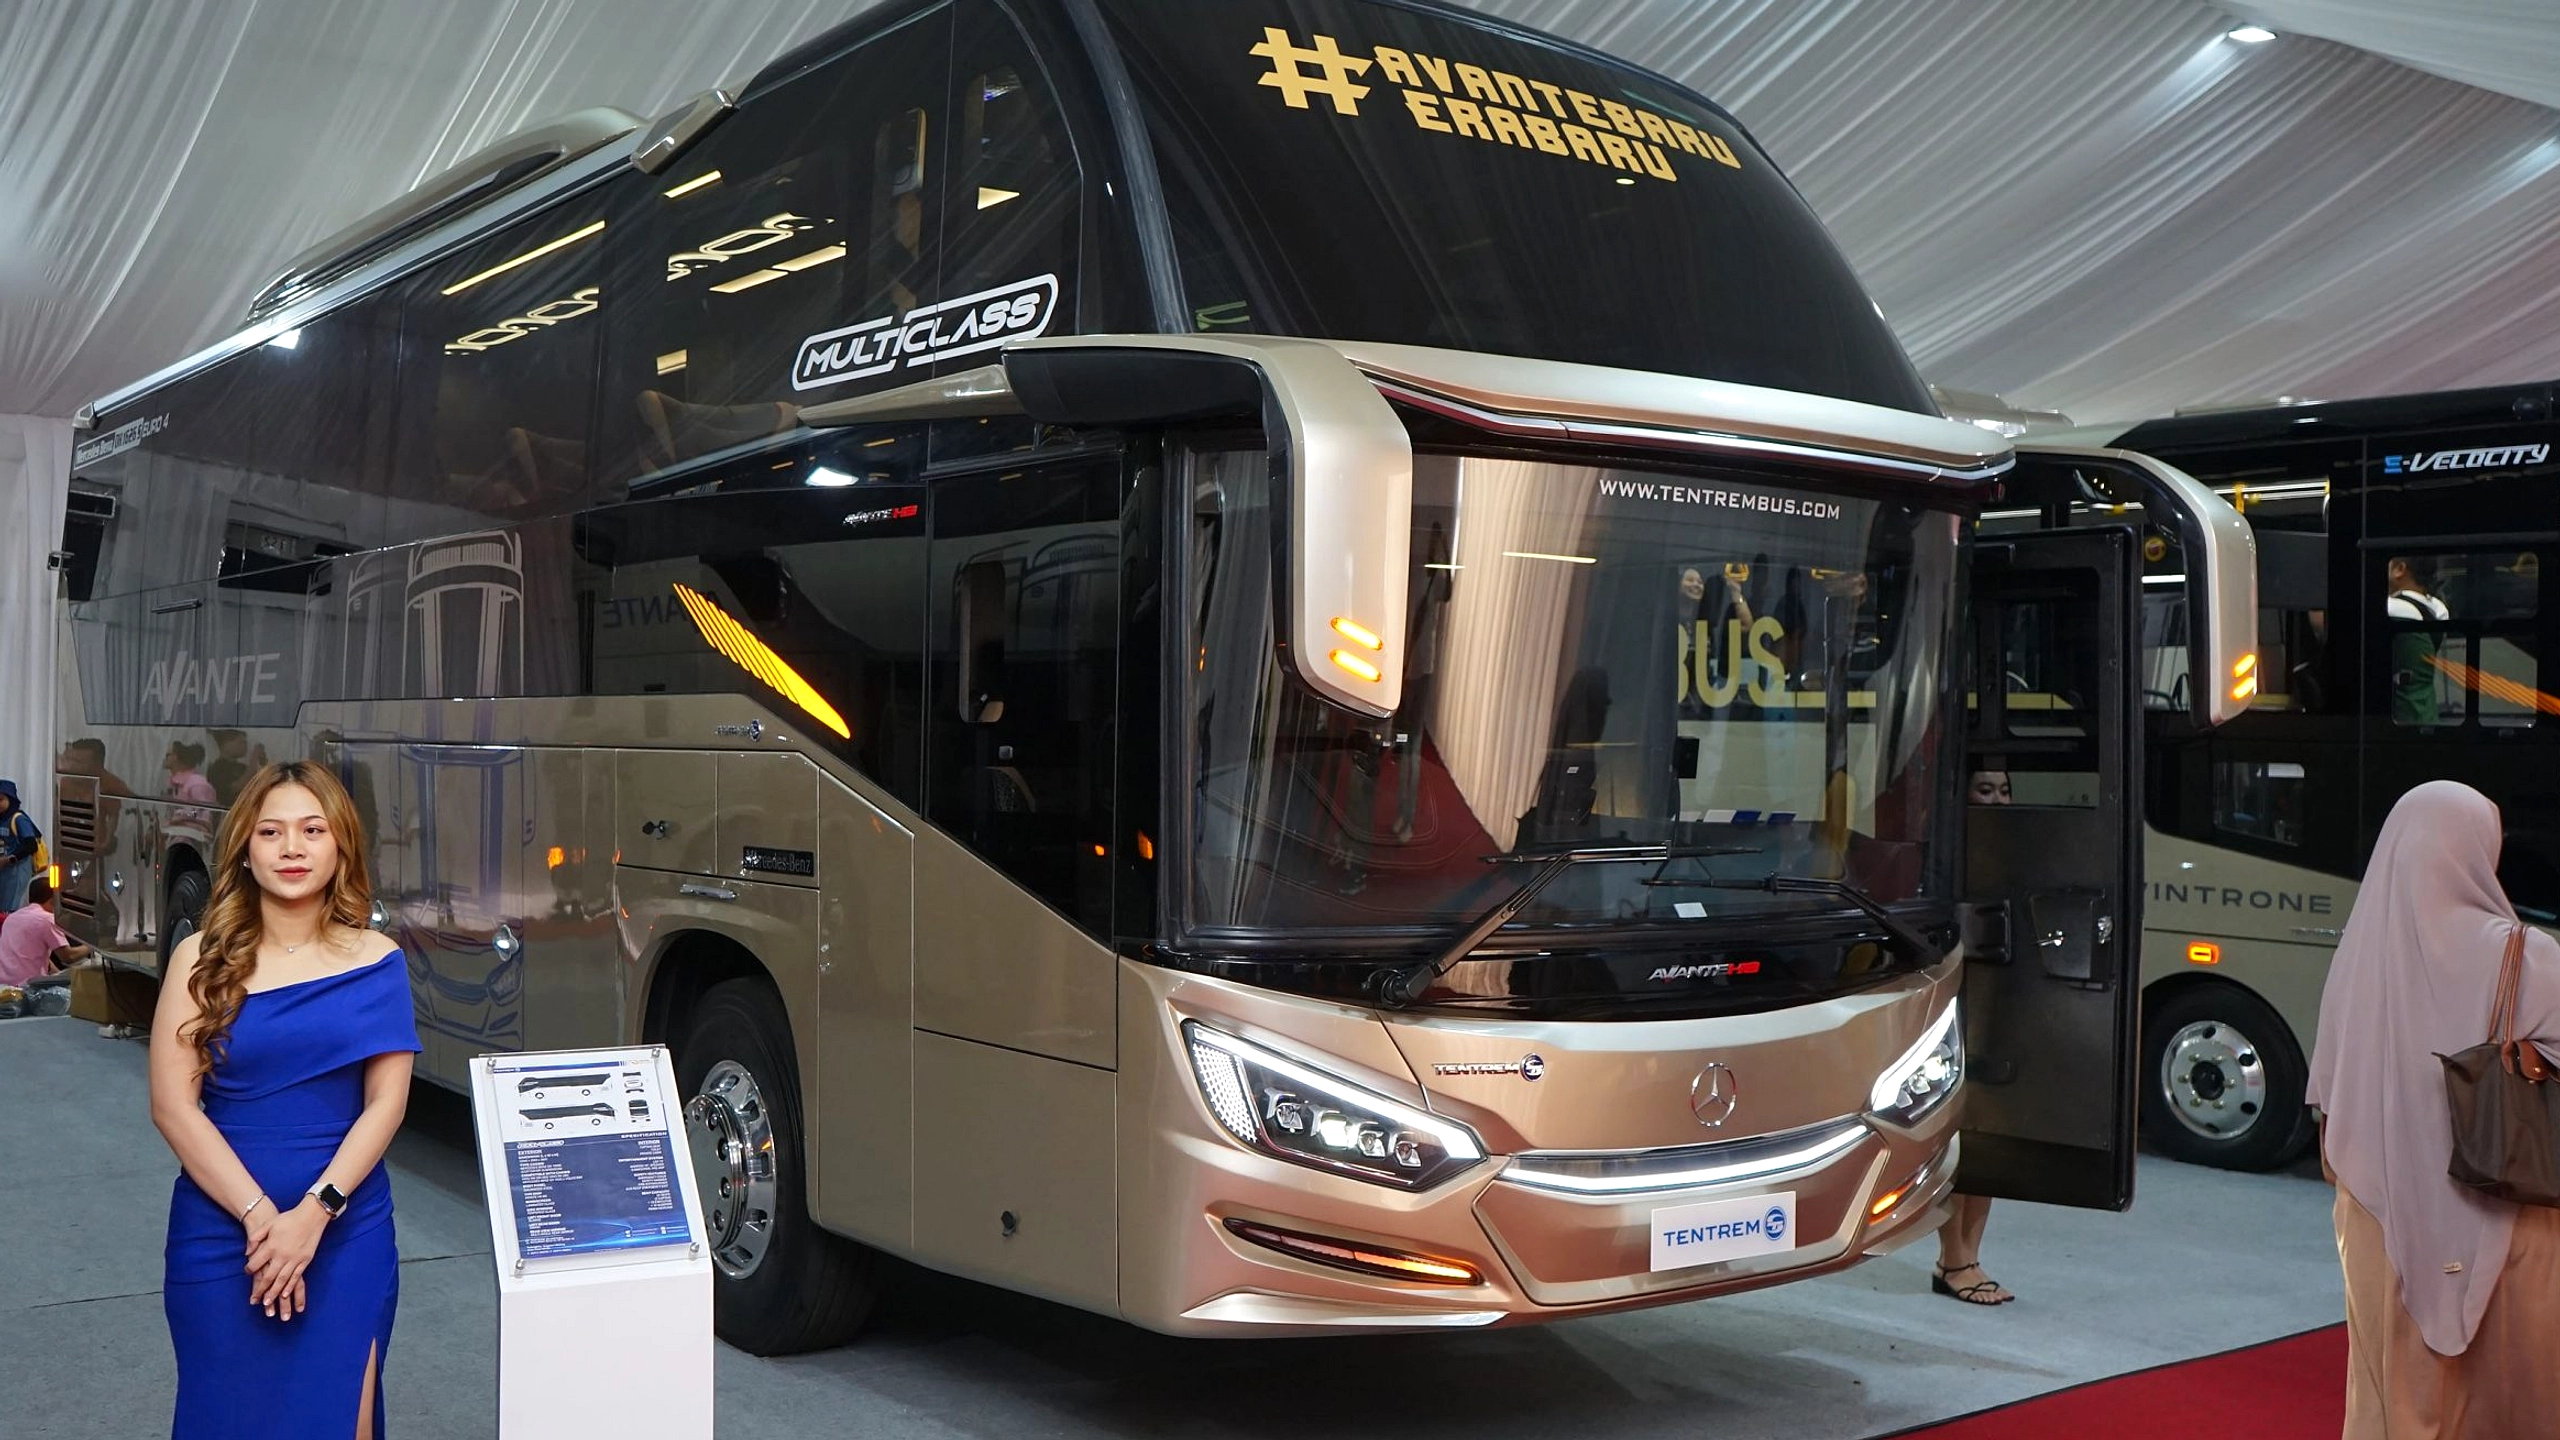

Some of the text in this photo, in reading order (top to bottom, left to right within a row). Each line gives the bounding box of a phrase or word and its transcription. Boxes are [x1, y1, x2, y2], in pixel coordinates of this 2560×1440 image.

[1405, 91, 1678, 182] ERABARU
[803, 292, 1041, 377] MULTICLASS
[2384, 443, 2550, 474] E-VELOCITY
[1599, 479, 1840, 520] WWW.TENTREMBUS.COM
[141, 651, 280, 720] AVANTE
[2143, 883, 2331, 915] INTRONE
[1432, 1063, 1520, 1076] TENTREM
[1664, 1219, 1760, 1246] TENTREM
